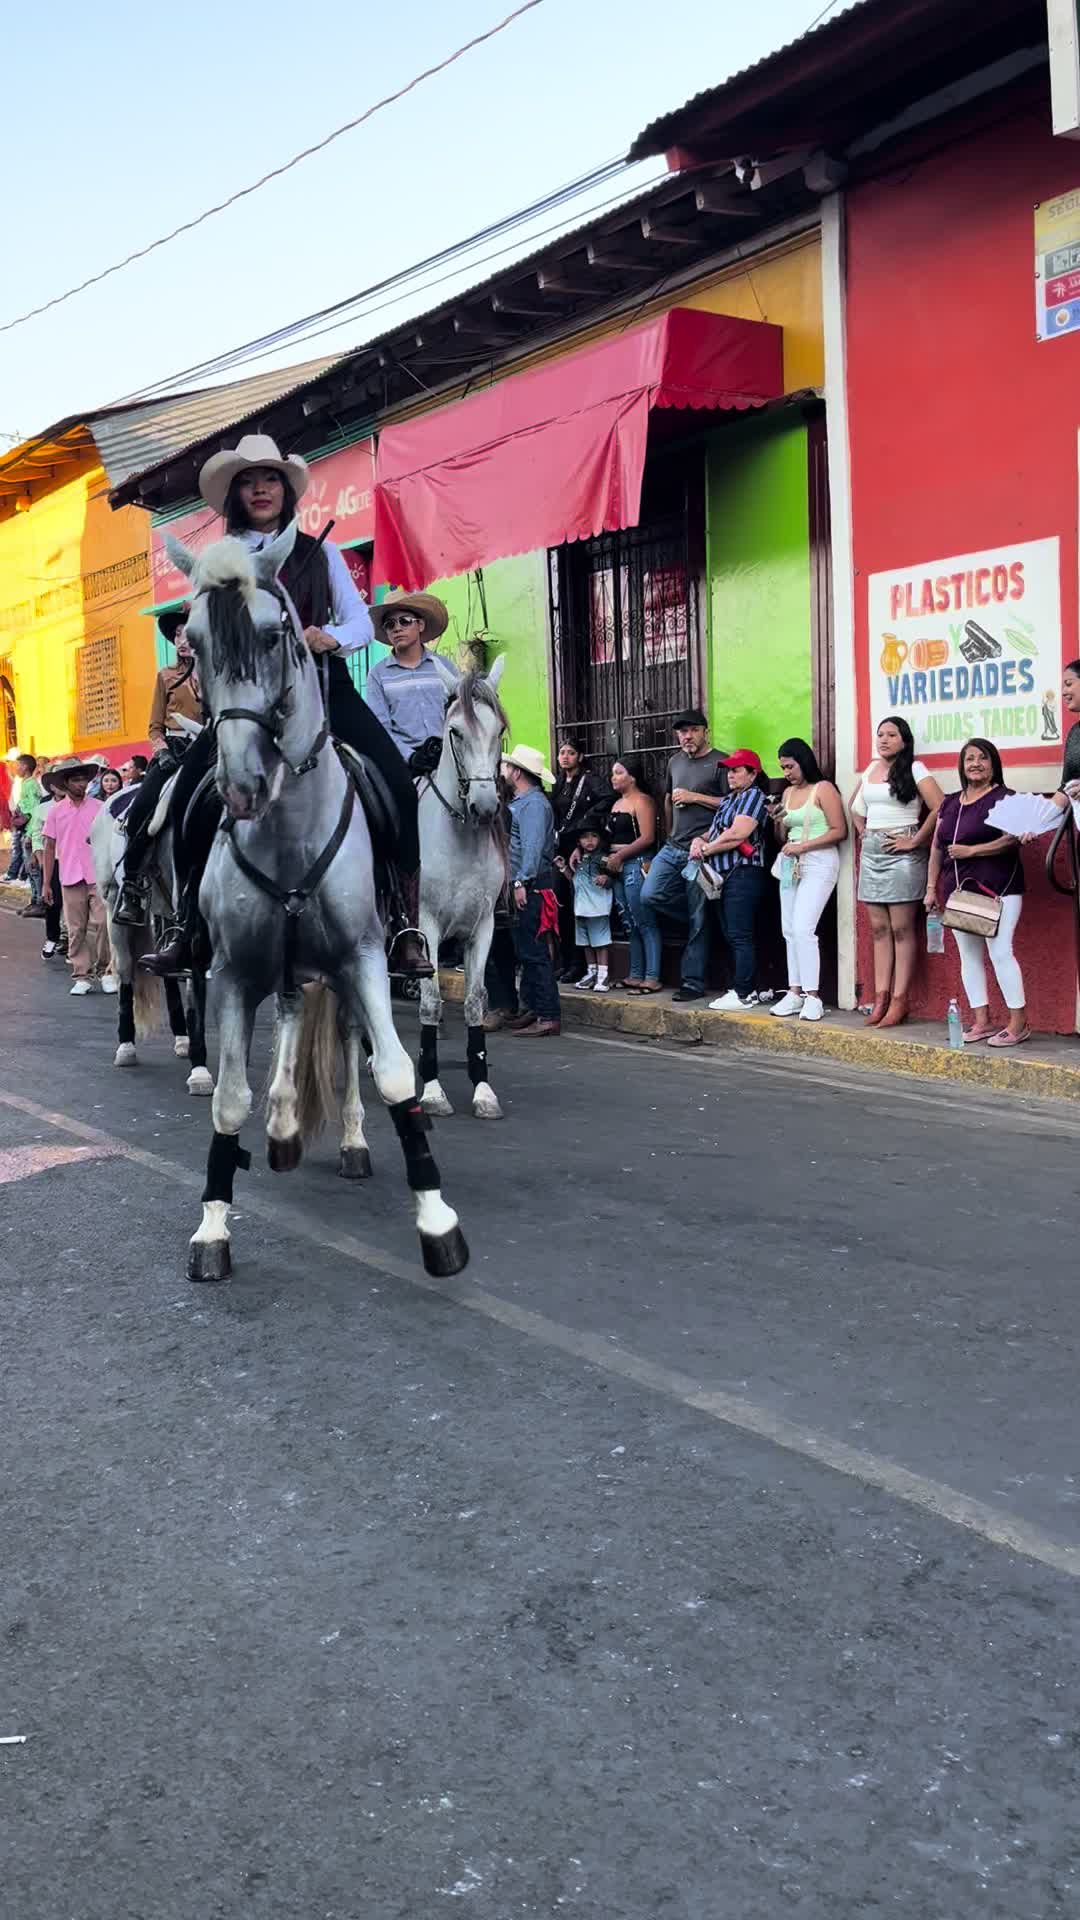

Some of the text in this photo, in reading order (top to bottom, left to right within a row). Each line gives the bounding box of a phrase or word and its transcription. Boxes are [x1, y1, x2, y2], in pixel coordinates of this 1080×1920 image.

[890, 561, 1025, 621] PLASTICOS
[887, 658, 1035, 707] VARIEDADES
[922, 711, 974, 742] JUDAS
[981, 705, 1037, 738] TADEO
